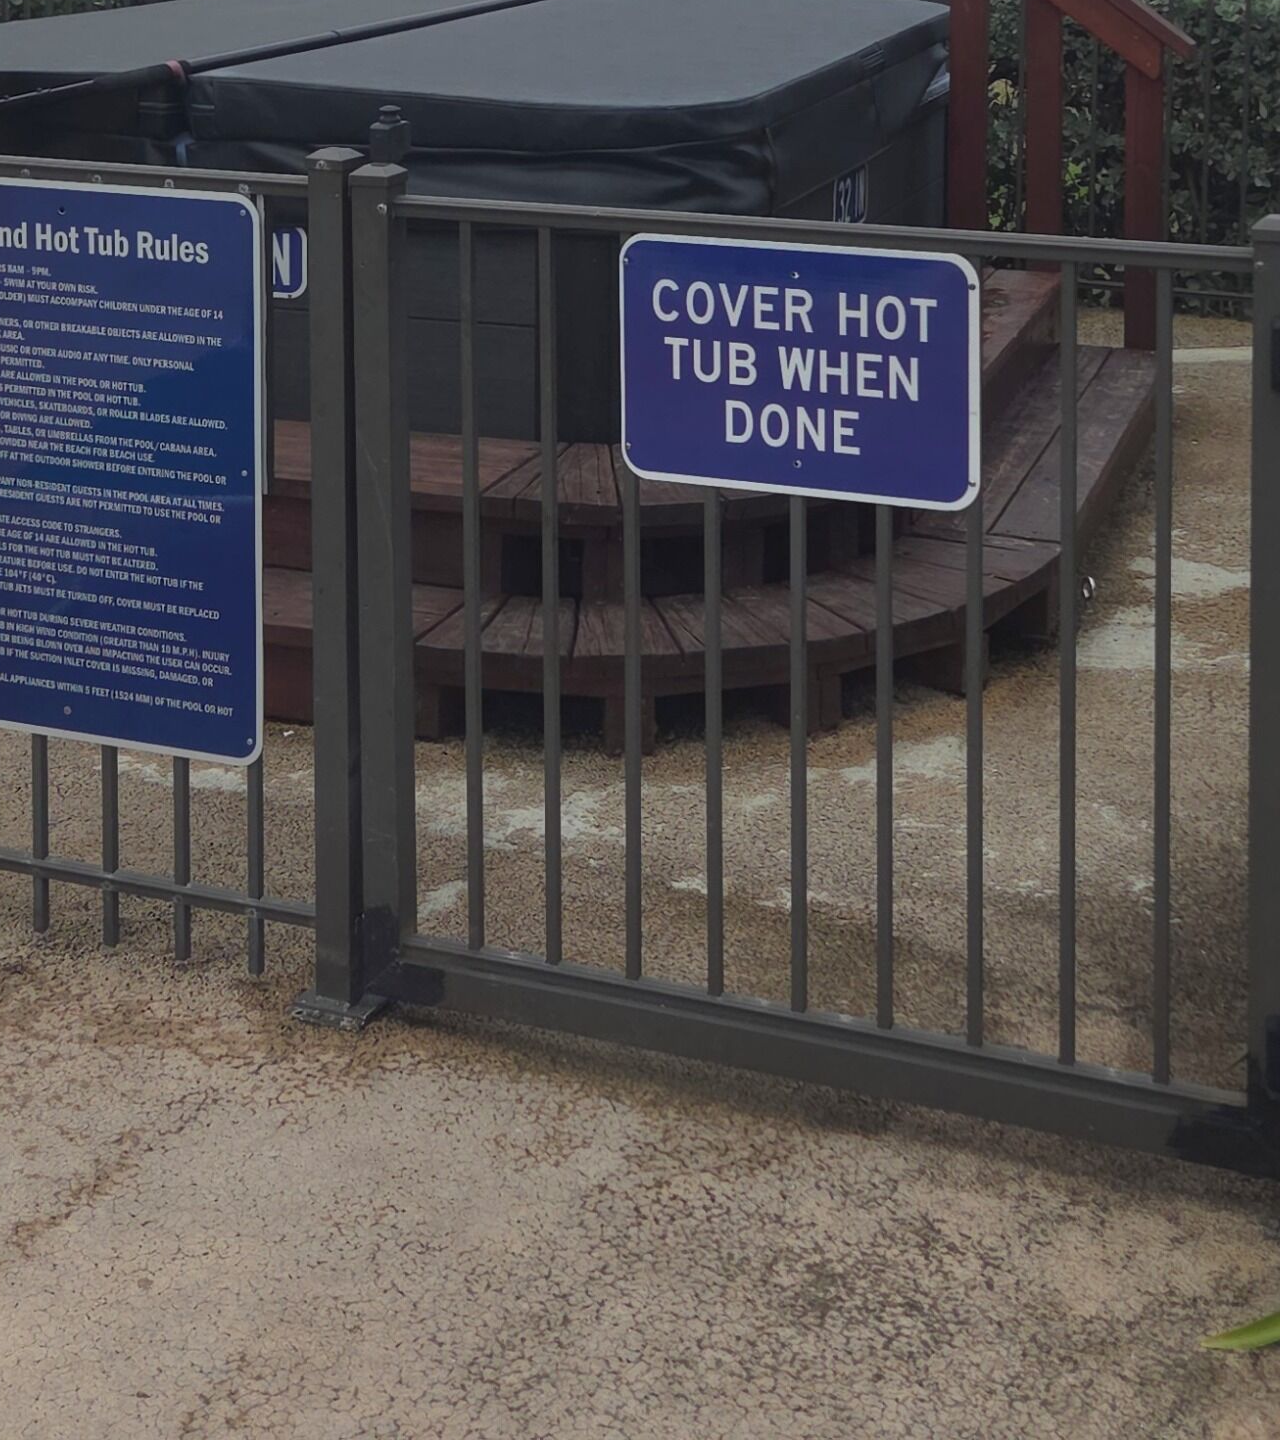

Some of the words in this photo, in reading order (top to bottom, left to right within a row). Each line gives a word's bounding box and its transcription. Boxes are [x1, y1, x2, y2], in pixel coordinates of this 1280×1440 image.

[35, 223, 79, 254] Hot
[84, 227, 129, 258] Tub
[137, 231, 209, 264] Rules
[3, 277, 25, 287] SWIM
[26, 279, 35, 288] AT
[36, 280, 56, 290] YOUR
[58, 282, 76, 292] OWN
[27, 293, 48, 303] MUST
[50, 295, 97, 308] ACCOMPANY
[98, 299, 137, 311] CHILDREN
[138, 303, 166, 314] UNDER
[167, 305, 182, 315] THE
[183, 307, 199, 317] AGE
[200, 308, 211, 318] OF
[213, 309, 223, 319] 14
[652, 278, 813, 333] COVER
[839, 292, 937, 342] HOT
[22, 319, 33, 328] OR
[34, 320, 59, 331] OTHER
[60, 323, 105, 335] BREAKABLE
[107, 327, 140, 338] OBJECTS
[141, 330, 157, 340] ARE
[158, 332, 195, 343] ALLOWED
[196, 335, 205, 344] IN
[206, 336, 221, 346] THE
[19, 345, 30, 354] OR
[31, 346, 56, 357] OTHER
[57, 349, 81, 359] AUDIO
[82, 351, 91, 360] AT
[93, 352, 108, 362] ANY
[131, 356, 151, 366] ONLY
[152, 358, 193, 370] PERSONAL
[664, 337, 758, 386] TUB
[778, 346, 919, 402] WHEN
[0, 369, 15, 379] ARE
[16, 371, 51, 383] ALLOWED
[52, 374, 61, 384] IN
[62, 375, 76, 385] THE
[77, 377, 97, 387] POOL
[98, 379, 110, 389] OR
[111, 380, 126, 390] HOT
[725, 400, 860, 455] DONE
[11, 516, 40, 527] ACCESS
[41, 519, 62, 530] CODE
[63, 522, 73, 532] TO
[7, 608, 21, 618] HOT
[23, 610, 37, 620] TUB
[38, 612, 68, 625] DURING
[69, 617, 98, 629] SEVERE
[99, 621, 135, 634] WEATHER
[6, 647, 13, 656] IF
[14, 648, 28, 659] THE
[29, 651, 62, 664] SUCTION
[63, 656, 84, 667] INLET
[85, 659, 110, 671] COVER
[112, 663, 120, 672] IS
[201, 676, 213, 686] OR
[9, 674, 55, 689] APPLIANCES
[56, 681, 83, 693] WITHIN
[84, 685, 90, 694] 5
[91, 686, 109, 697] FEET
[154, 696, 164, 706] OF
[166, 697, 180, 708] THE
[182, 700, 202, 711] POOL
[203, 703, 215, 713] OR
[216, 705, 232, 716] HOT
